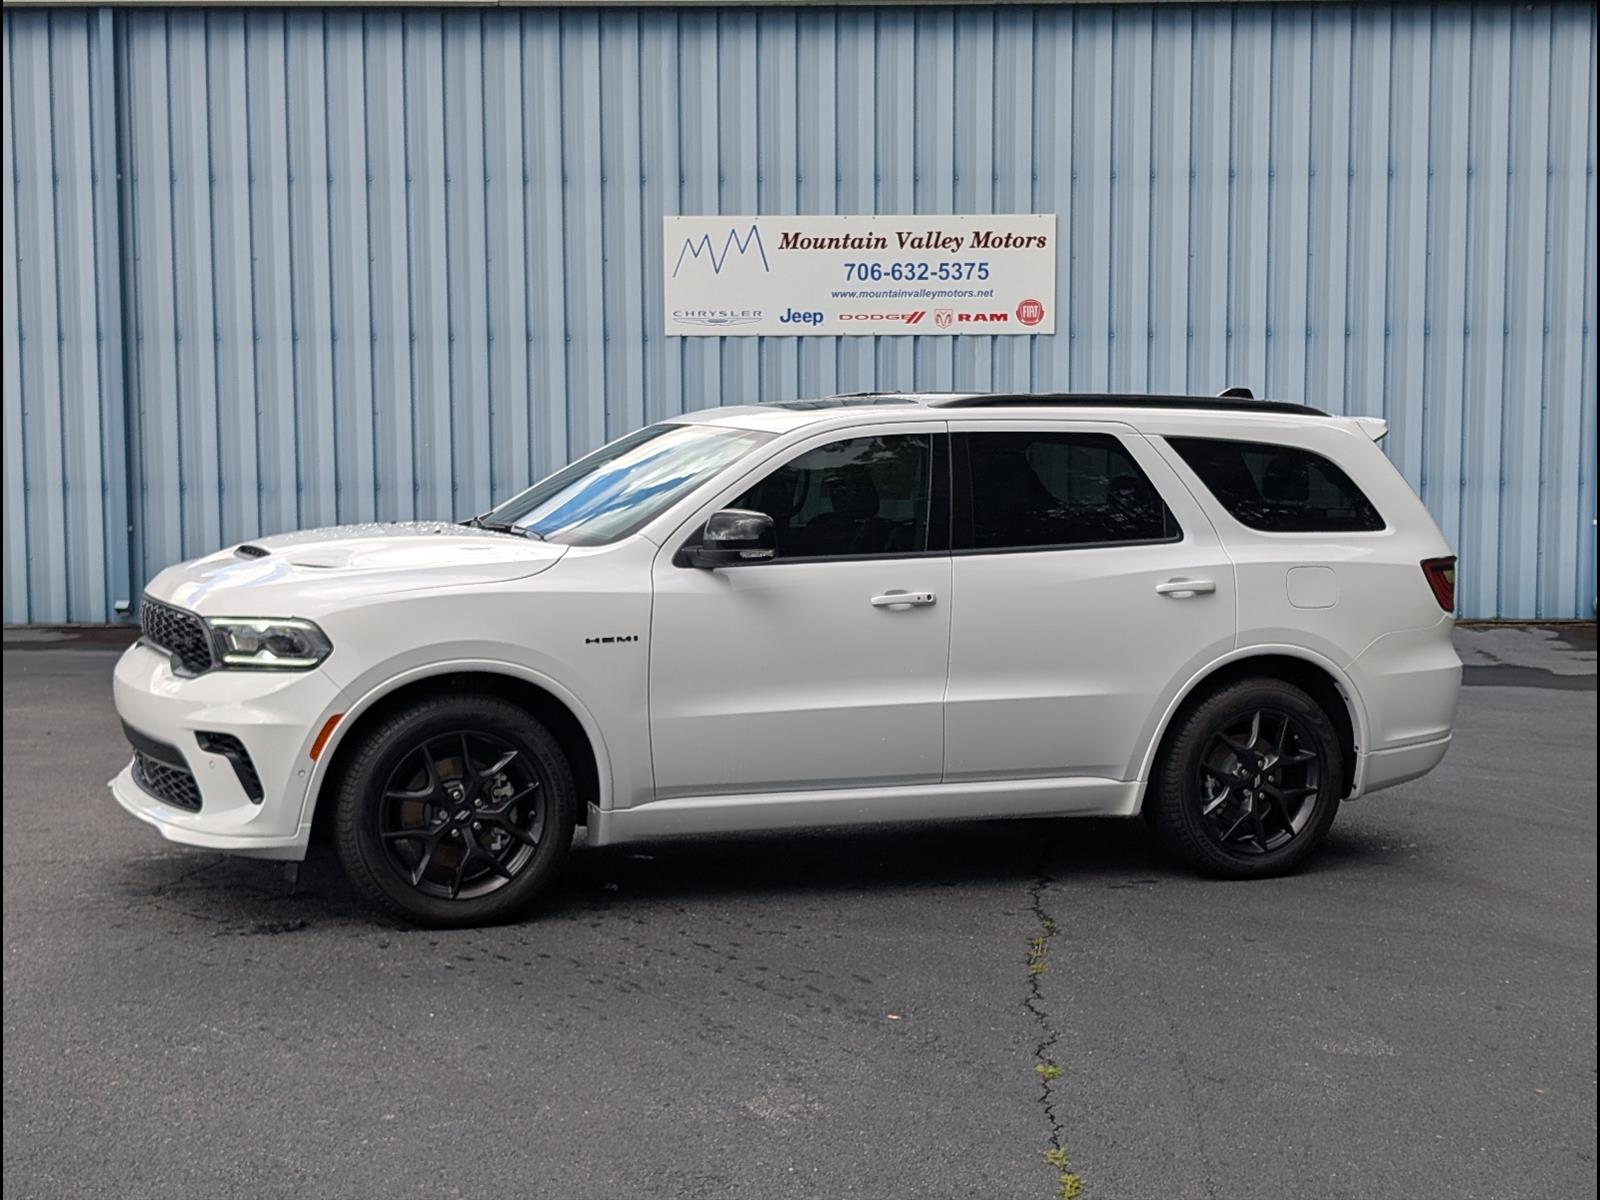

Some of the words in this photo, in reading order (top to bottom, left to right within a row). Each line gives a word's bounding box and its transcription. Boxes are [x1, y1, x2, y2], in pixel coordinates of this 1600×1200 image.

[778, 231, 888, 250] Mountain
[895, 231, 964, 253] Valley
[969, 231, 1047, 249] Motors
[844, 262, 990, 281] 706-632-5375
[831, 288, 994, 300] www.mountainvalleymotors.net
[780, 308, 824, 326] Jeep
[839, 313, 912, 321] DODGE
[957, 313, 1008, 322] RAM
[1022, 305, 1040, 319] FIAT
[585, 635, 639, 645] HEMI
